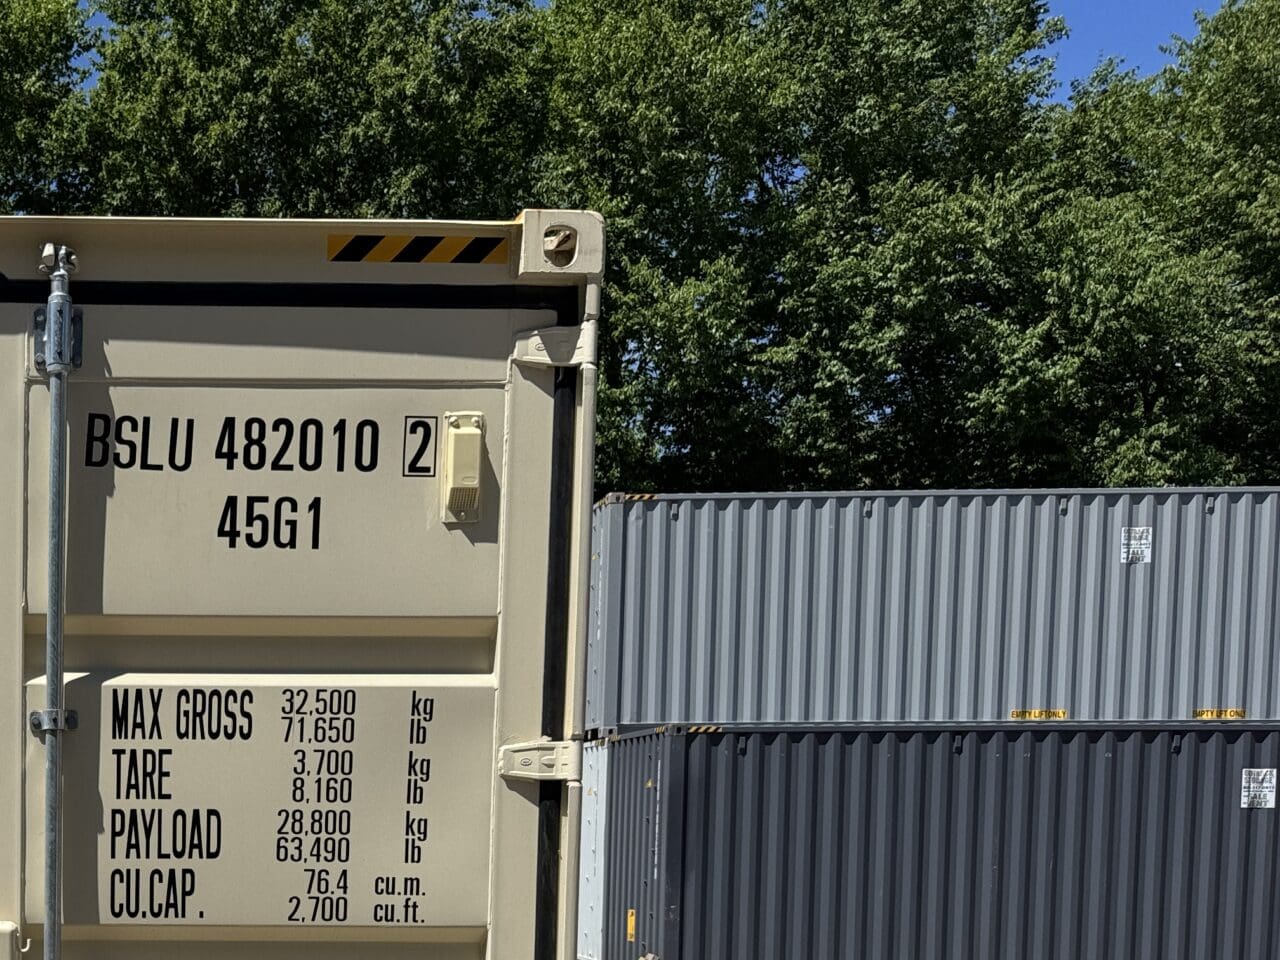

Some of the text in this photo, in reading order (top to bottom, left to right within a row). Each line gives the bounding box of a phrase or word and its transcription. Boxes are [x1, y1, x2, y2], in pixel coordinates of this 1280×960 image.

[84, 412, 432, 473] BSLU 482010 2
[217, 495, 322, 550] 45G1
[111, 688, 254, 741] MAX GROSS
[281, 689, 434, 722] 32,500 kg
[281, 717, 427, 745] 71,650 lb
[112, 748, 173, 800] TARE
[293, 750, 431, 782] 3,700 kg
[292, 777, 424, 804] 8,160 lb
[110, 808, 221, 859] PAYLOAD
[276, 809, 428, 841] 28,800 kg
[276, 837, 421, 864] 63,490 lb
[110, 868, 205, 919] CU.CAP.
[303, 869, 426, 896] 76.4 cu.m.
[287, 896, 425, 923] 2,700 cu.ft.
